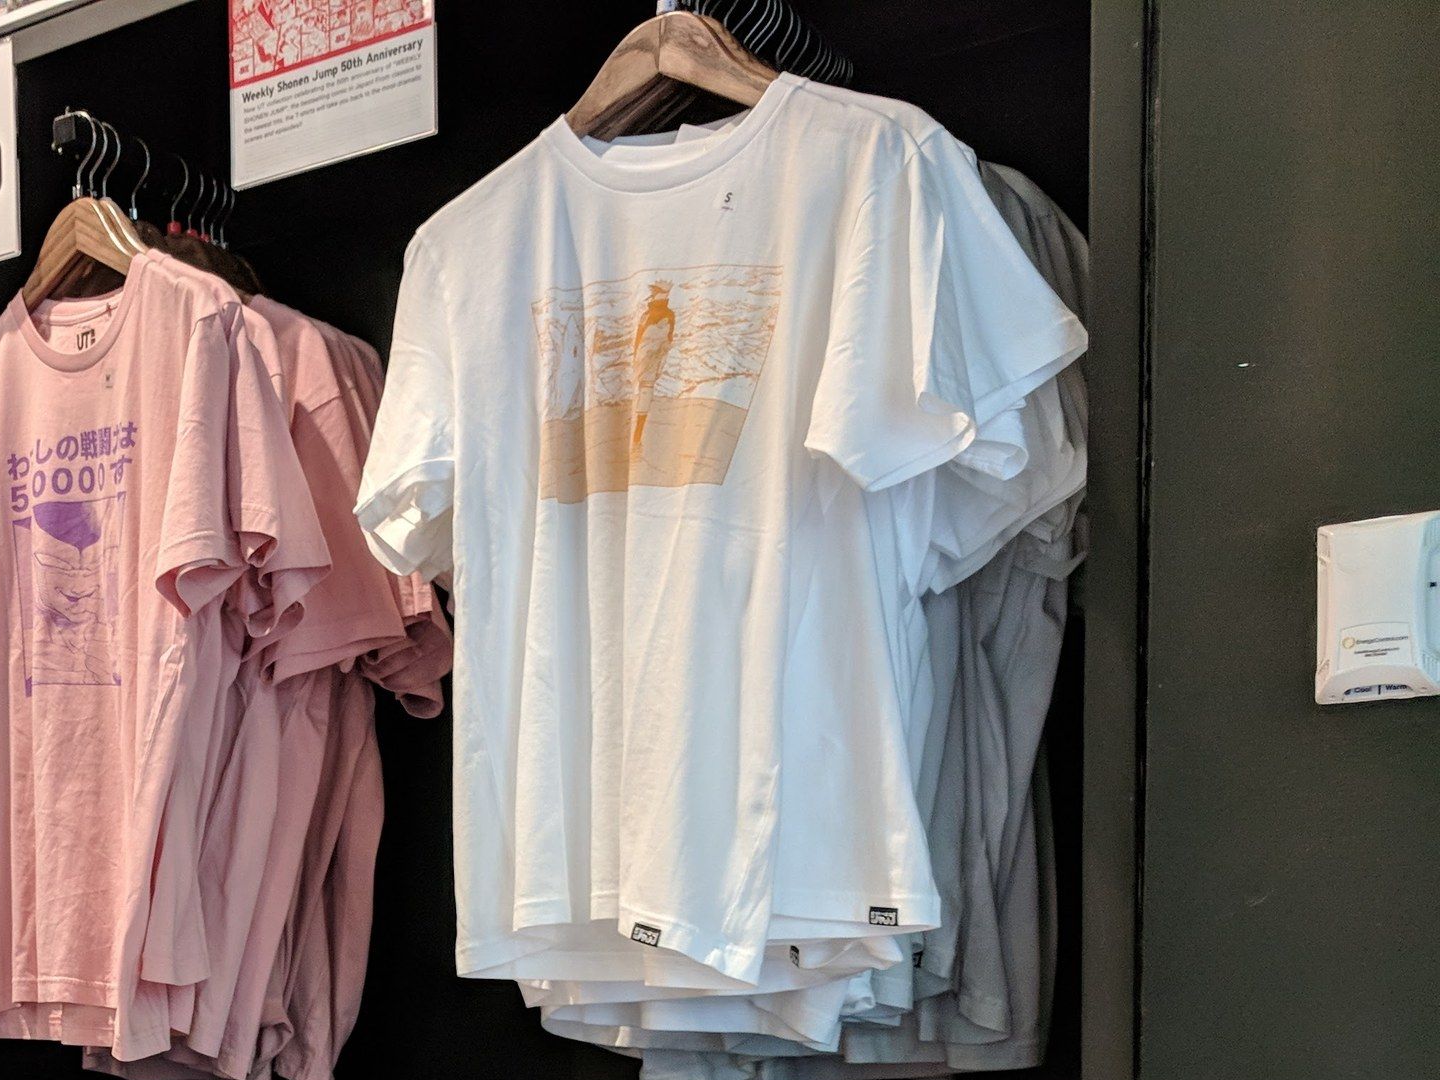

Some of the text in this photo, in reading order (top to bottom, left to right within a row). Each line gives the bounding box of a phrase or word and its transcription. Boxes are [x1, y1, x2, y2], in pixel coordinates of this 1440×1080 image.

[241, 85, 274, 103] Weekly
[277, 75, 309, 92] Shonen
[312, 66, 338, 81] Jump
[341, 57, 363, 72] 50th
[365, 38, 423, 66] Anniversary
